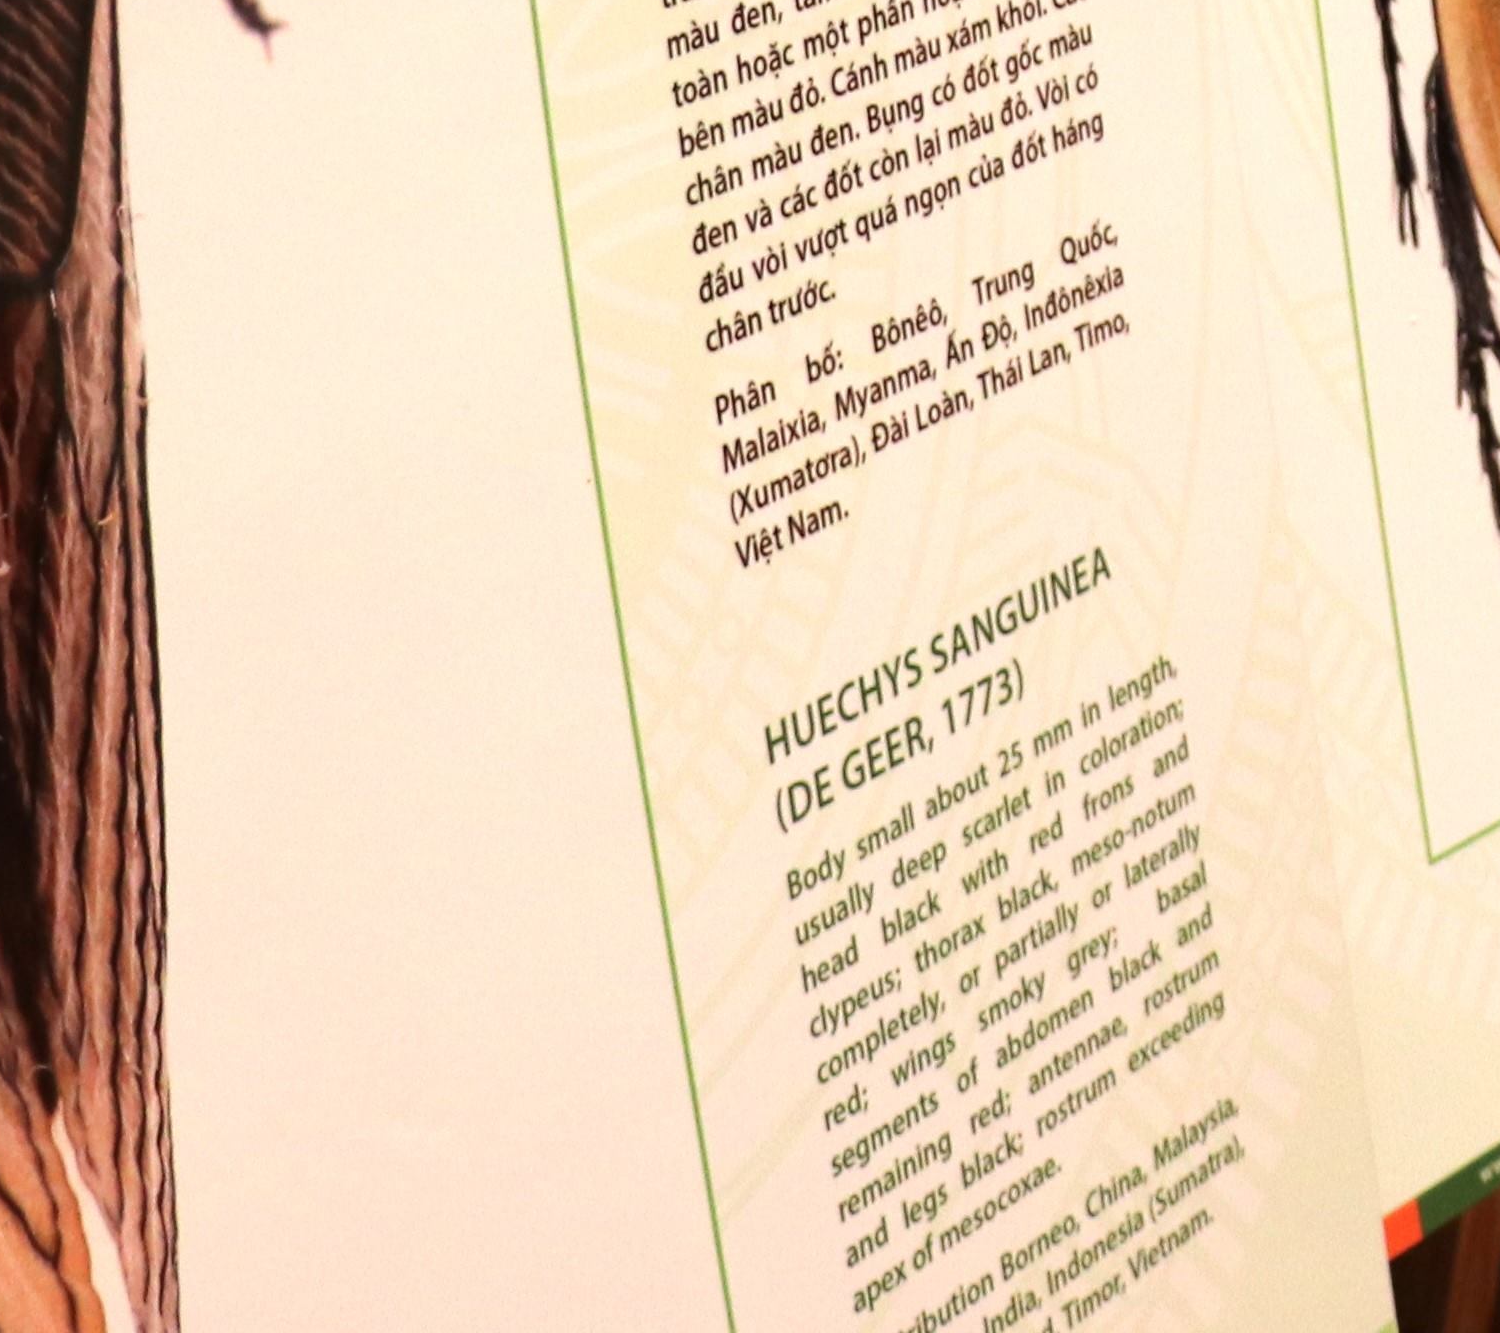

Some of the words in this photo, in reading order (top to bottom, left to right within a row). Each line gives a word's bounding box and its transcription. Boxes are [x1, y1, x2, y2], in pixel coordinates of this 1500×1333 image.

[676, 119, 726, 159] bên
[730, 97, 785, 138] màu
[788, 76, 827, 114] đỏ.
[829, 51, 889, 97] Cánh
[892, 36, 943, 74] màu
[945, 17, 993, 54] xám
[684, 164, 744, 207] chân
[750, 140, 804, 181] màu
[809, 121, 861, 157] đen.
[865, 92, 926, 135] Bụng
[930, 72, 957, 107] có
[961, 53, 1001, 95] đốt
[1004, 37, 1044, 84] gốc
[1047, 23, 1093, 60] màu
[691, 218, 739, 255] đen
[743, 197, 774, 233] và
[779, 182, 819, 219] các
[823, 158, 865, 201] đốt
[868, 147, 911, 182] còn
[914, 127, 943, 166] lại
[946, 111, 995, 150] màu
[999, 90, 1034, 127] đỏ.
[1034, 73, 1071, 111] Vòi
[1074, 61, 1099, 95] có
[704, 309, 764, 353] chân
[766, 278, 837, 326] trước.
[713, 379, 777, 426] Phân
[804, 339, 845, 385] bố:
[870, 296, 948, 354] Bônêô,
[970, 260, 1036, 306] Trung
[1058, 218, 1119, 265] Quốc,
[721, 408, 827, 474] Malaixia,
[833, 358, 938, 421] Myanma,
[945, 328, 975, 370] Ấn
[980, 313, 1018, 352] Độ,
[1023, 265, 1125, 331] Inđônêxia
[729, 434, 867, 526] (Xumatơra),
[870, 409, 911, 453] Đài
[975, 354, 1024, 400] Thái
[1027, 341, 1072, 377] Lan,
[1072, 312, 1130, 352] Timo,
[733, 524, 785, 569] Việt
[786, 500, 850, 545] Nam.
[763, 646, 924, 765] HUECHYS
[929, 546, 1112, 674] SANGUINEA
[775, 763, 836, 834] (DE
[840, 715, 935, 791] GEER,
[941, 657, 1025, 735] 1773)
[785, 848, 846, 901] Body
[855, 801, 916, 861] small
[925, 762, 990, 820] about
[997, 740, 1024, 778] 25
[1032, 718, 1074, 757] mm
[1080, 701, 1102, 728] in
[1107, 655, 1178, 712] length,
[794, 881, 875, 946] usually
[891, 841, 948, 889] deep
[961, 786, 1033, 847] scarlet
[1044, 770, 1066, 797] in
[1078, 698, 1184, 775] coloration;
[799, 933, 860, 994] head
[879, 888, 943, 946] black
[960, 847, 1010, 895] with
[1028, 809, 1064, 855] red
[1081, 774, 1135, 821] frons
[1152, 732, 1190, 778] and
[809, 966, 902, 1038] clypeus;
[913, 914, 987, 973] thorax
[996, 868, 1059, 922] black,
[1070, 783, 1196, 876] meso-notum
[816, 990, 946, 1084] completely,
[958, 965, 981, 995] or
[994, 902, 1079, 981] partially
[1091, 881, 1112, 909] or
[1123, 824, 1200, 889] laterally
[823, 1082, 869, 1132] red;
[889, 1031, 957, 1087] wings
[977, 970, 1046, 1032] smoky
[1066, 926, 1118, 980] grey;
[1155, 859, 1208, 914] basal
[830, 1091, 940, 1178] segments
[956, 1055, 978, 1094] of
[995, 989, 1095, 1069] abdomen
[1108, 939, 1163, 993] black
[1177, 900, 1213, 947] and
[837, 1131, 953, 1223] remaining
[969, 1087, 1012, 1135] red;
[1027, 1016, 1128, 1095] antennae,
[1143, 950, 1220, 1017] rostrum
[845, 1215, 890, 1268] and
[901, 1183, 949, 1229] legs
[1035, 1068, 1117, 1138] rostrum
[1127, 991, 1225, 1073] exceeding
[853, 1260, 908, 1313] apex
[911, 1231, 934, 1271] of
[1046, 1210, 1145, 1296] Indonesia
